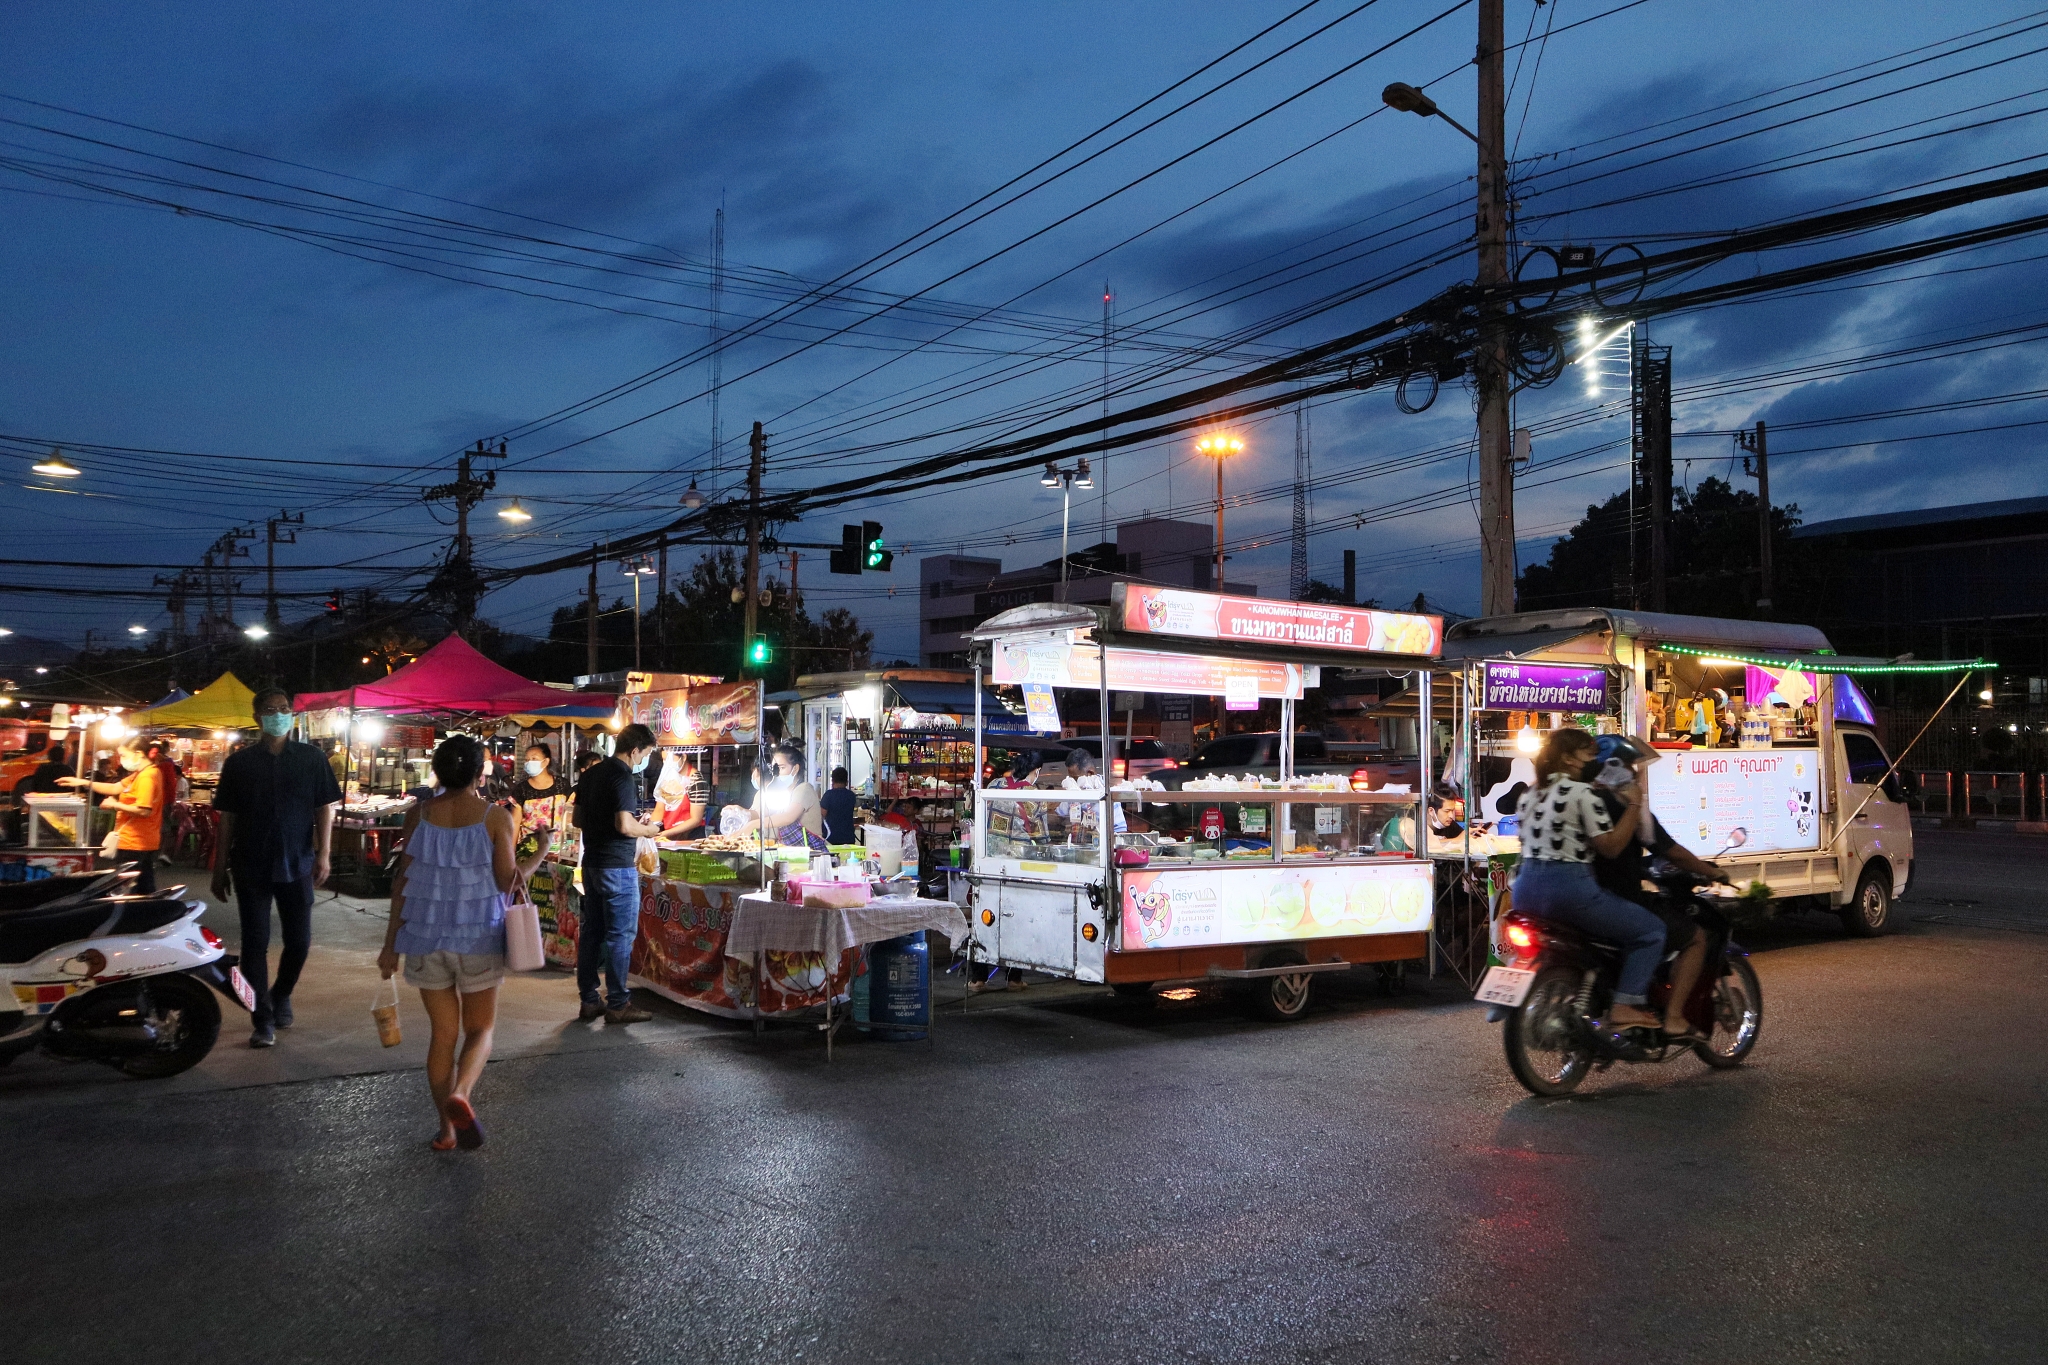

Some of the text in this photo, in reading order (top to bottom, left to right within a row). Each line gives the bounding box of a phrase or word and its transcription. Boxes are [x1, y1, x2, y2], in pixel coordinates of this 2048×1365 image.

[990, 591, 1035, 608] POLICE
[1252, 605, 1340, 622] KANOMWHAN MAESALEE
[1231, 617, 1355, 644] ขนมหวานแม่สาลี่
[1489, 665, 1520, 679] ตาชาติ
[1230, 680, 1253, 688] OPEN
[1489, 677, 1603, 705] ข้าวเหนียวมะม่วง
[1691, 758, 1728, 774] นมสด
